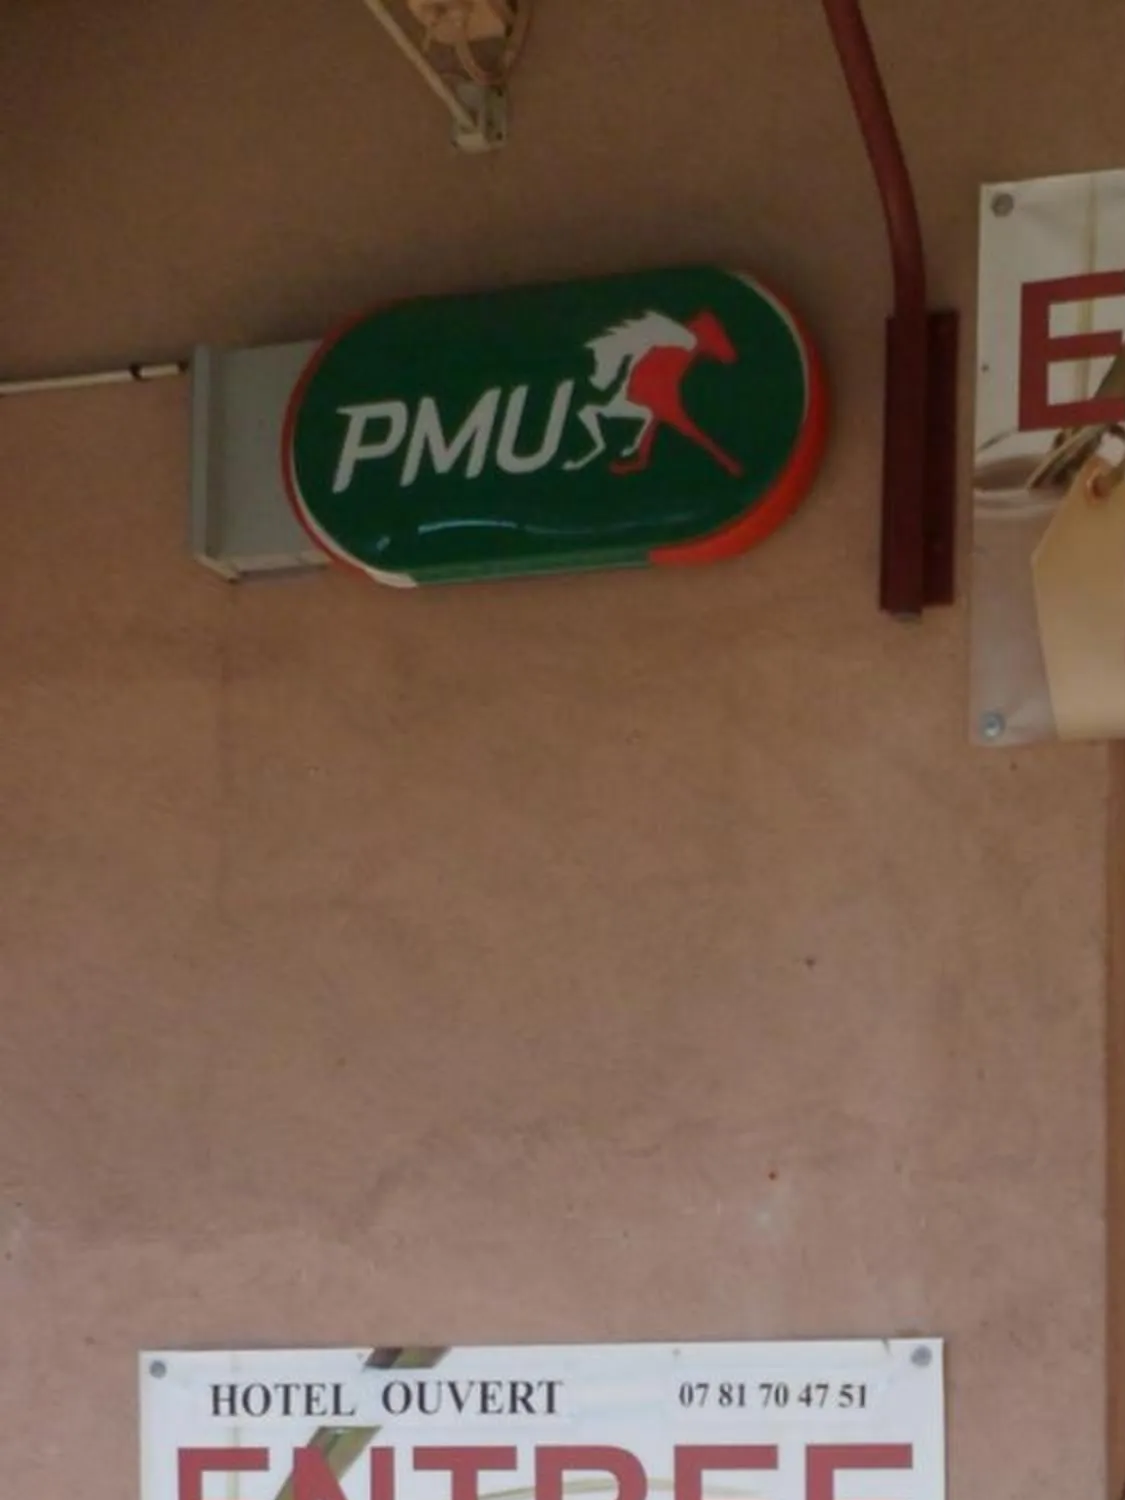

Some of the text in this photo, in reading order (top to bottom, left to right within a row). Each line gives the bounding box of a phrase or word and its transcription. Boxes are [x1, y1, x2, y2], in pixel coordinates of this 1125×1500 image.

[331, 379, 575, 493] PMU
[210, 1379, 564, 1417] HOTEL OUVERT
[679, 1382, 867, 1409] 07 81 70 47 51
